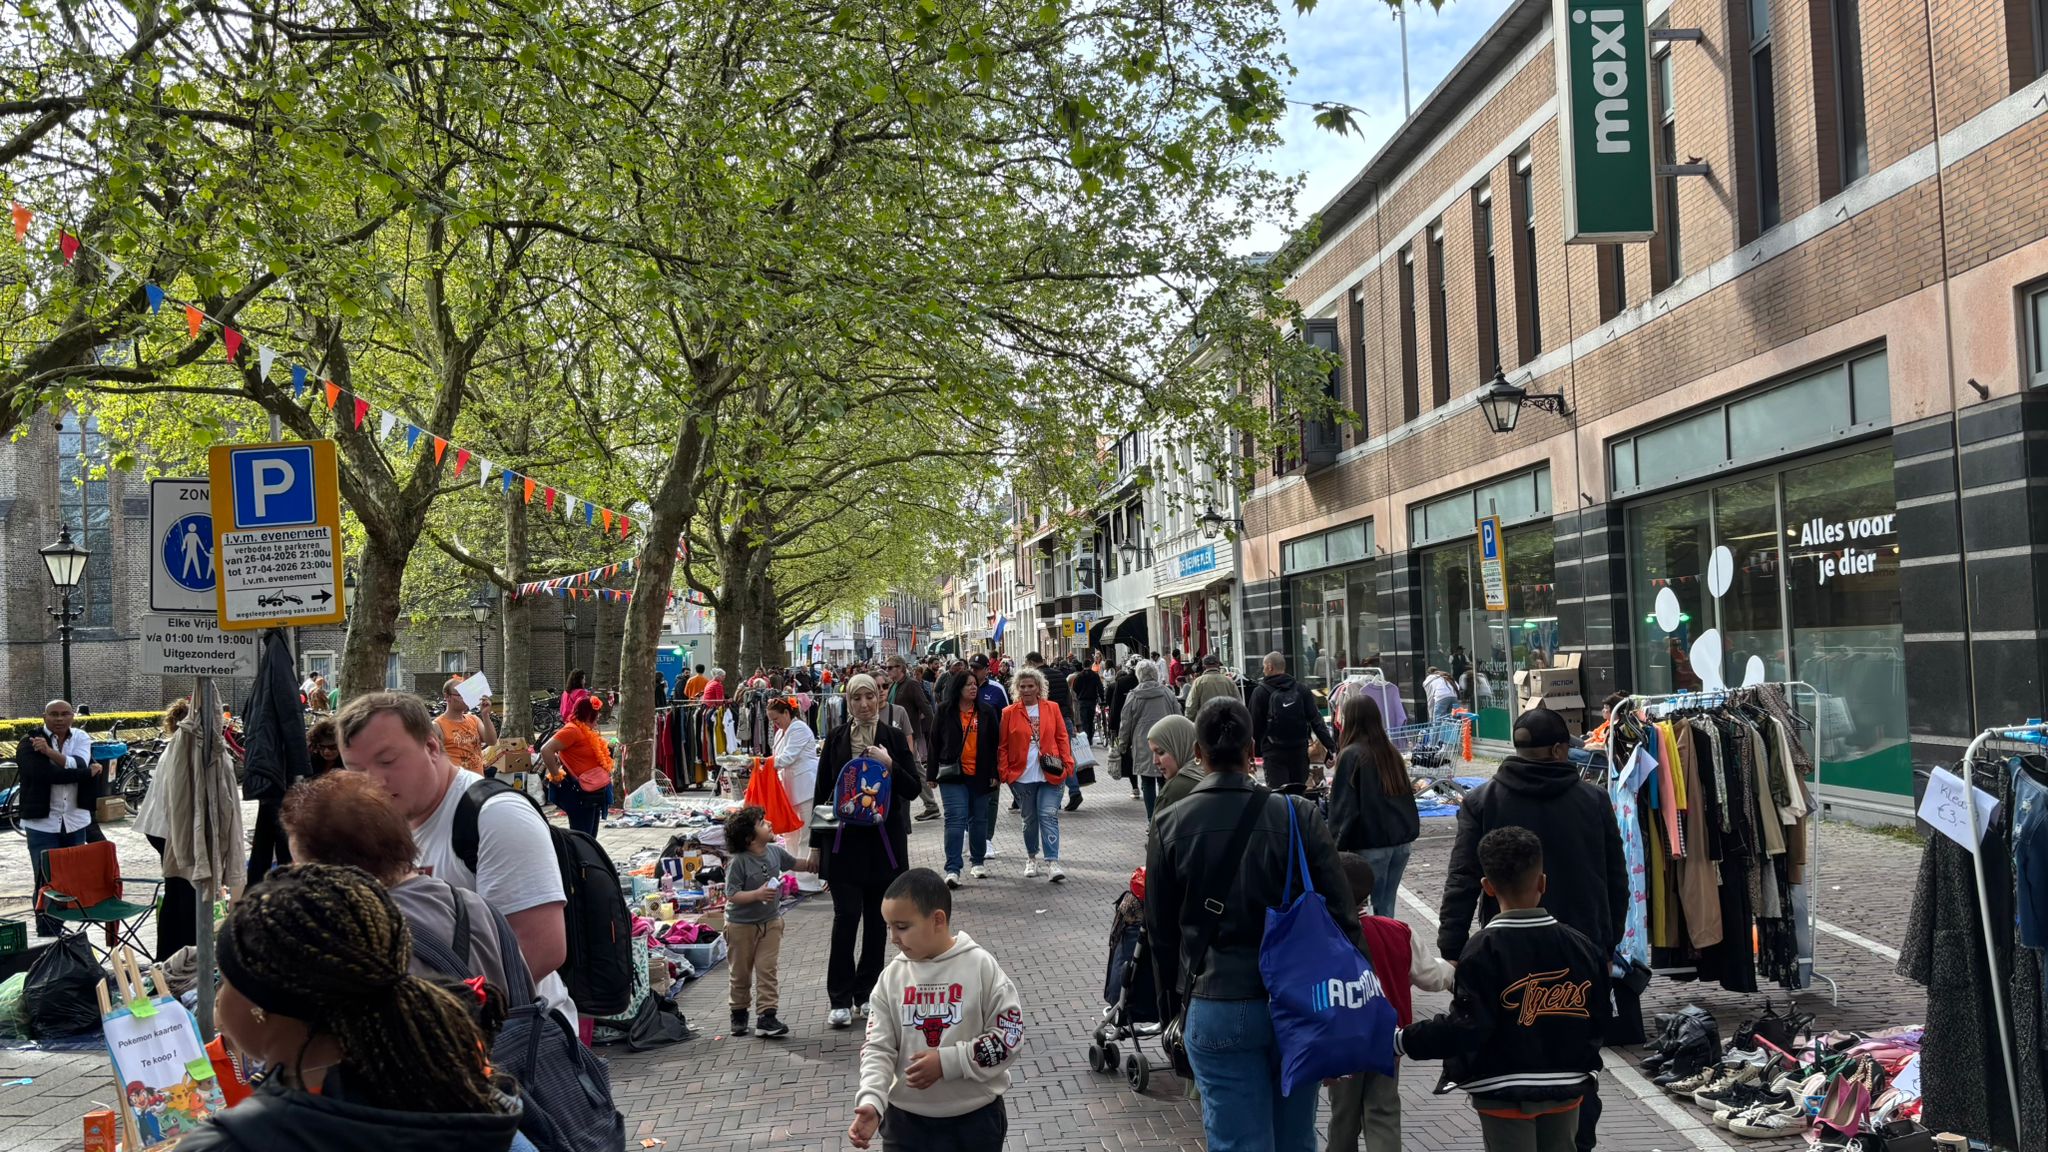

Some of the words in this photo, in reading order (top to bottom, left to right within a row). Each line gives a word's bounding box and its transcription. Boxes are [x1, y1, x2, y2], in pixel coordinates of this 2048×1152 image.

[1572, 9, 1630, 154] maxi
[252, 458, 295, 518] P
[225, 533, 258, 544] i.v.m.
[260, 527, 328, 541] evenement
[1800, 517, 1845, 547] Alles
[1847, 514, 1894, 540] voor
[234, 544, 272, 554] verboden
[274, 544, 282, 552] te
[285, 542, 320, 553] parkeren
[1483, 524, 1493, 555] P
[225, 557, 243, 566] van
[244, 551, 297, 564] 26-04-2026
[299, 549, 331, 559] 21:00u
[228, 568, 242, 577] tot
[245, 563, 298, 575] 27-04-2026
[300, 560, 332, 570] 23:00u
[1818, 552, 1836, 586] je
[1838, 547, 1877, 576] dier
[242, 577, 267, 586] i.v.m.
[268, 572, 317, 583] evenement
[168, 617, 191, 628] Elke
[146, 633, 162, 642] v/a
[165, 633, 194, 643] 01:00
[196, 634, 214, 644] t/m
[217, 634, 253, 645] 19:00u
[163, 648, 236, 660] Uitgezonderd
[163, 664, 235, 675] marktverkeer
[902, 982, 963, 1026] BULLS
[1499, 967, 1592, 1026] Tigers
[118, 1033, 153, 1048] Pokemon
[153, 1023, 183, 1038] kaarten
[140, 1058, 152, 1068] Te
[152, 1053, 173, 1065] koop
